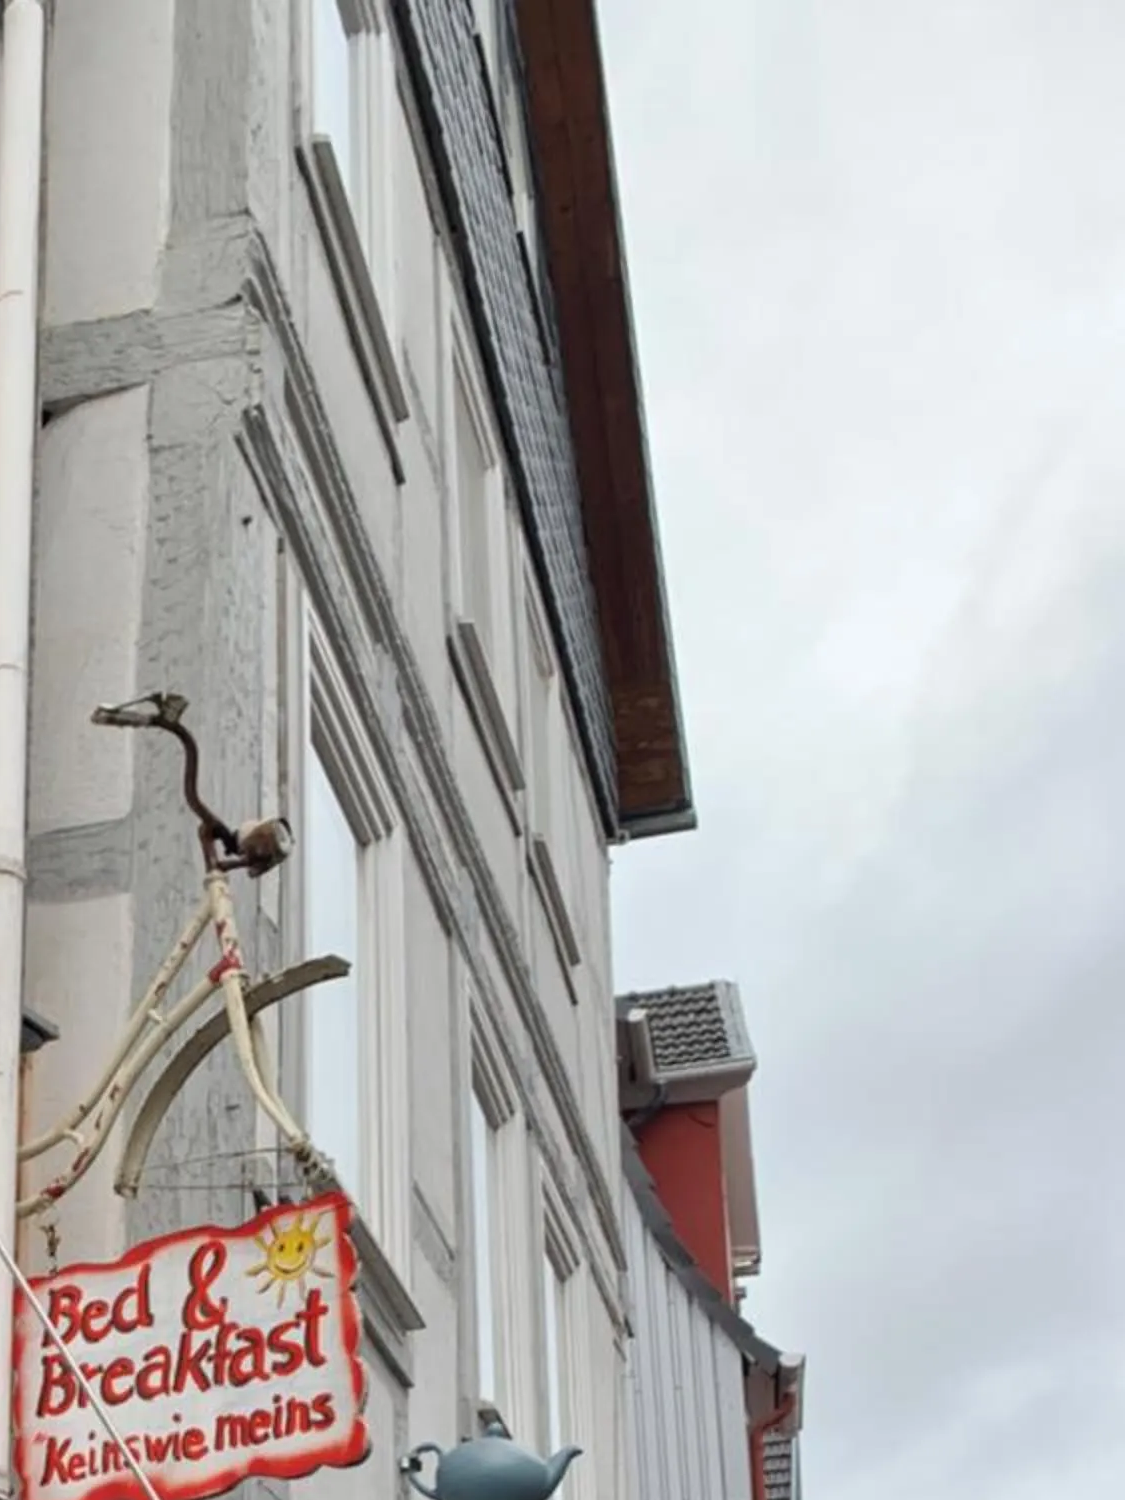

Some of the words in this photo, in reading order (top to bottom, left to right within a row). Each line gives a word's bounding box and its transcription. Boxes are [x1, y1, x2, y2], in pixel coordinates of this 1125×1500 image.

[40, 1262, 154, 1347] Bed
[182, 1239, 229, 1330] &
[36, 1288, 329, 1418] Breakfast
[143, 1413, 209, 1462] wie
[213, 1392, 336, 1451] meins
